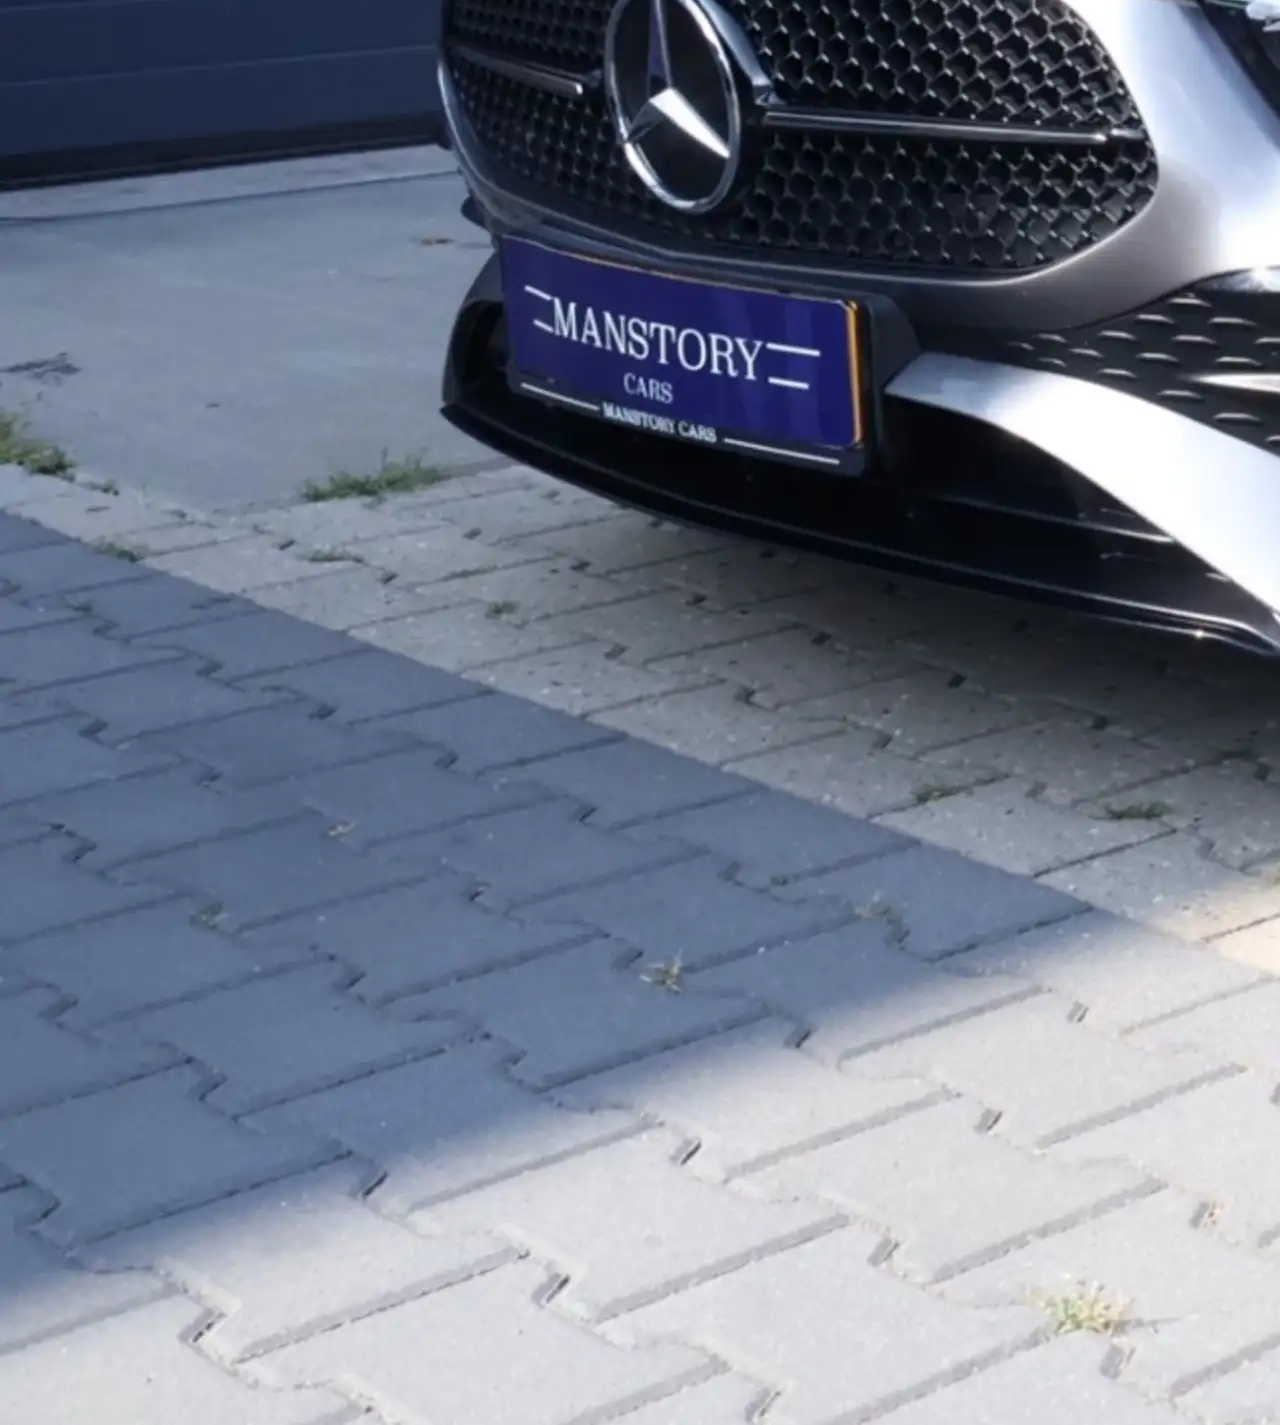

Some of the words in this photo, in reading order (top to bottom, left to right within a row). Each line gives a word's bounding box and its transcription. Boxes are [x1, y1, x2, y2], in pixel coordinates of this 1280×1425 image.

[552, 298, 763, 381] MANSTORY
[623, 372, 674, 404] CARS
[603, 402, 675, 434] MANSTORY
[678, 422, 717, 443] CARS
